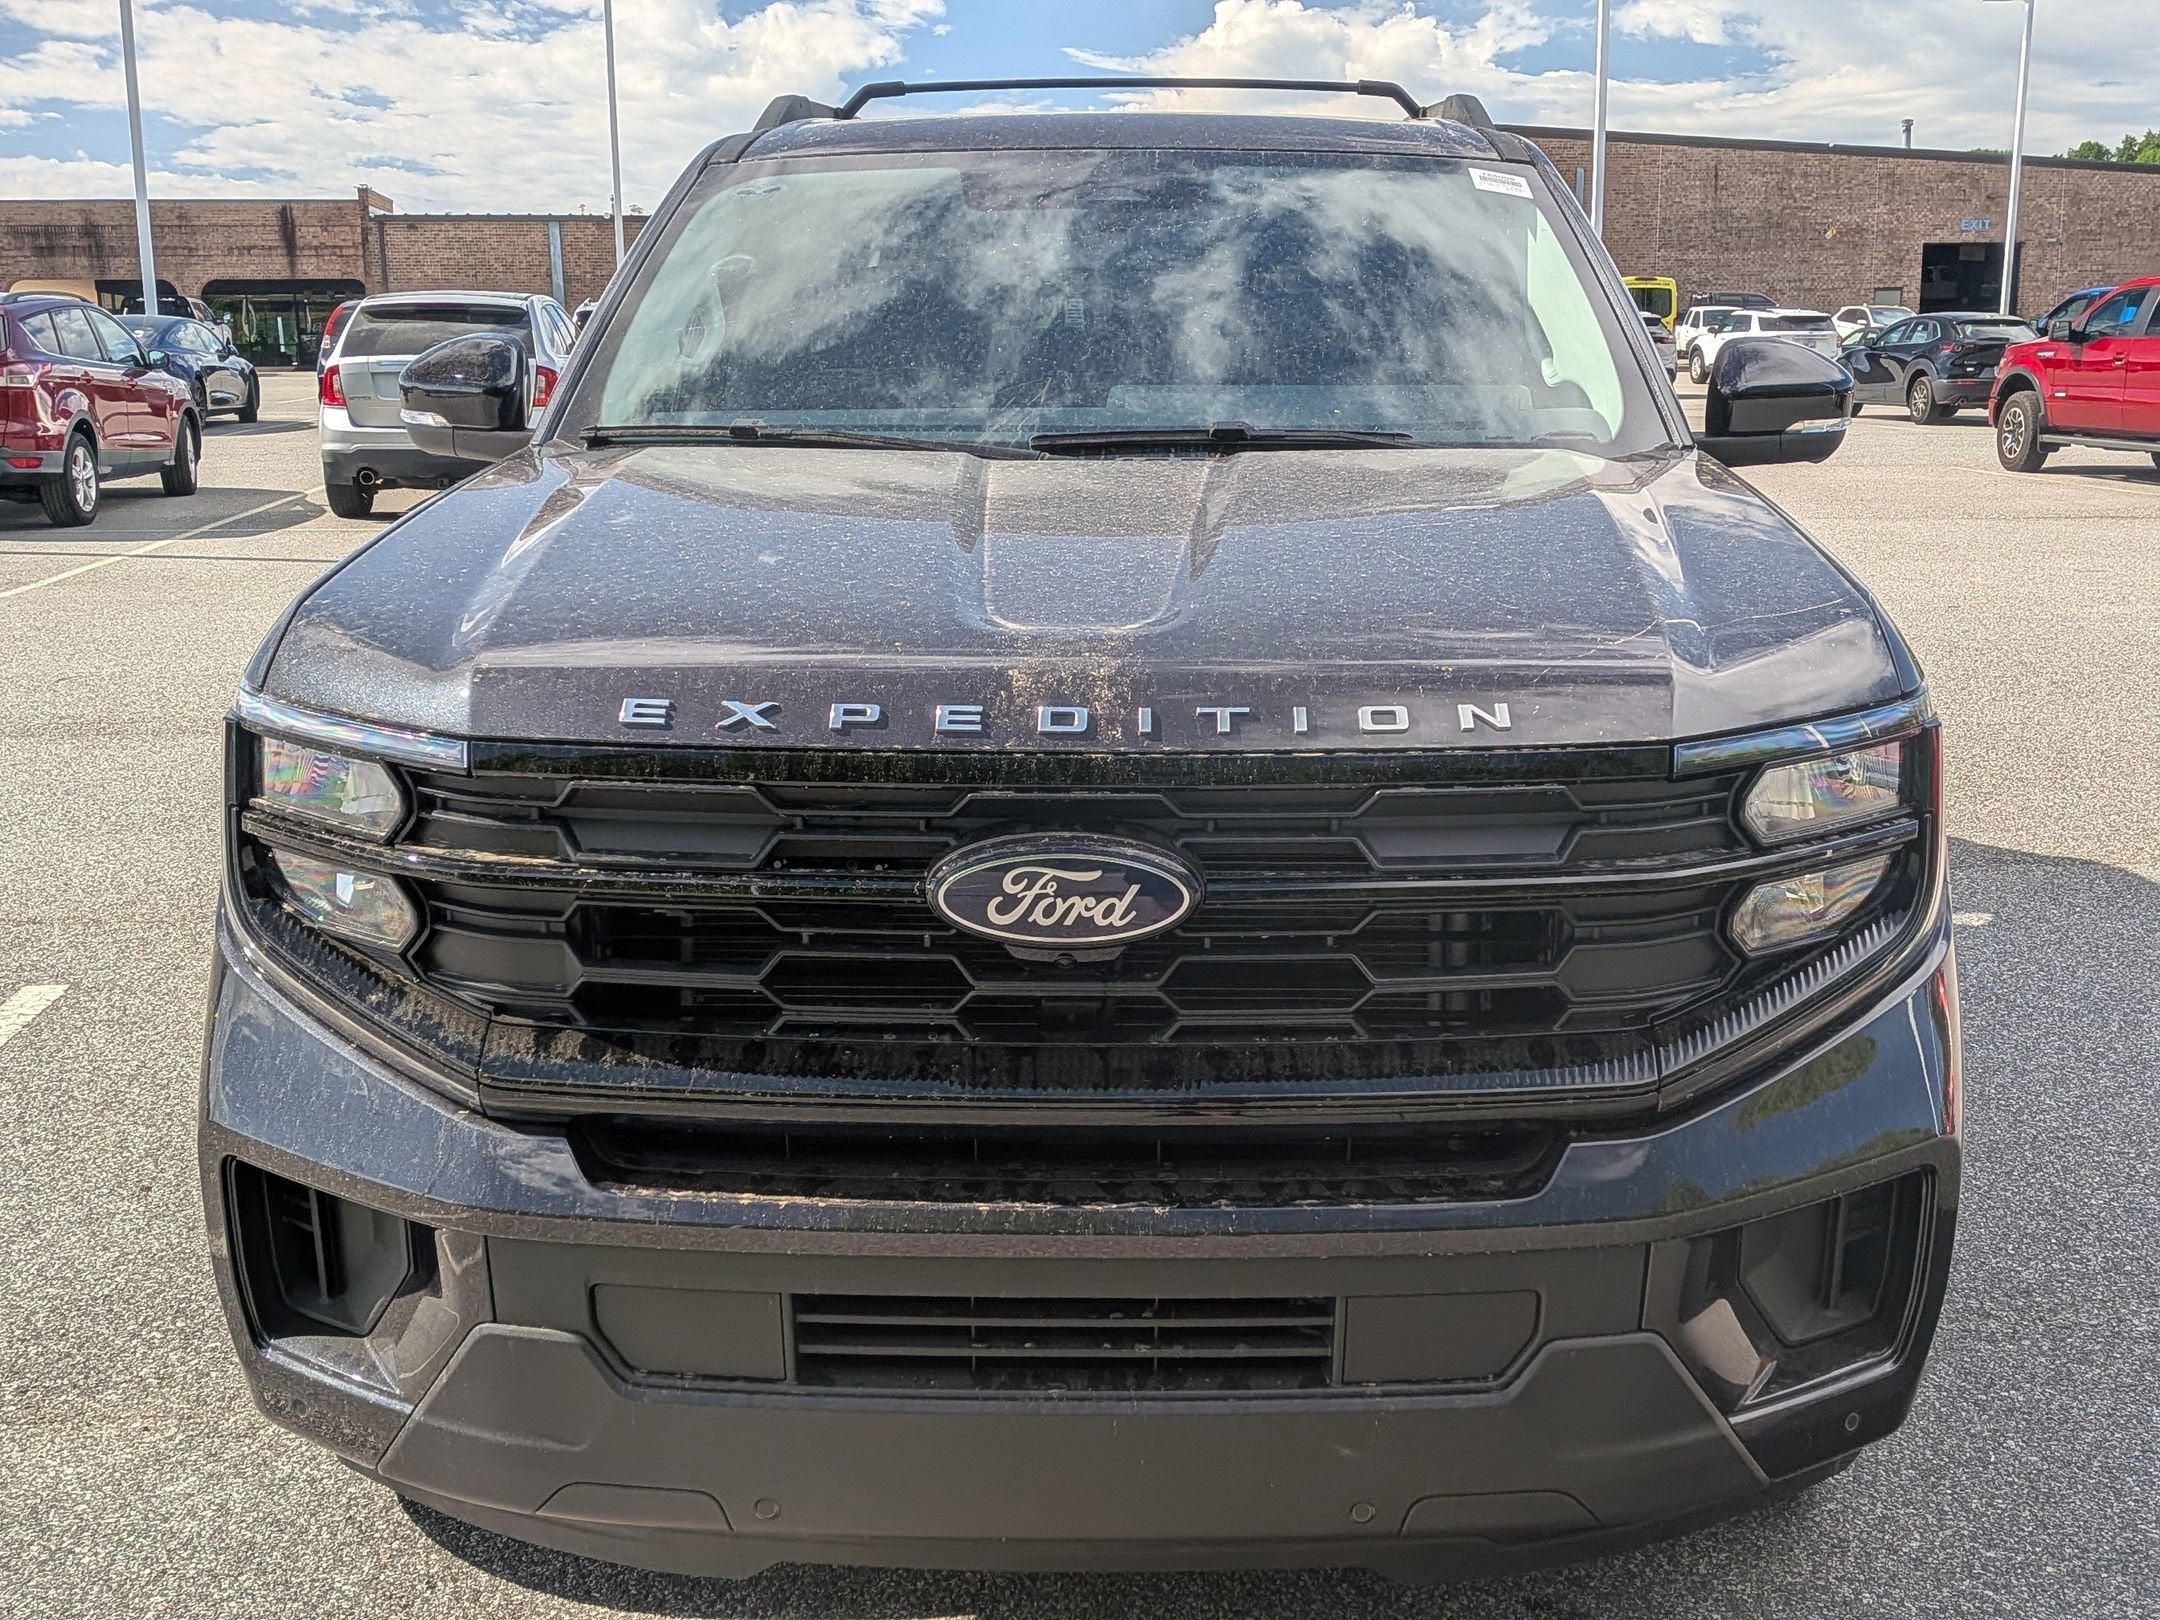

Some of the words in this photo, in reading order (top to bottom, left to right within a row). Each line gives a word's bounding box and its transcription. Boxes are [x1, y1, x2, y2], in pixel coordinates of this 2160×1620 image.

[1960, 219, 1991, 231] EXIT
[618, 697, 1512, 735] EXPEDITION
[987, 866, 1141, 927] Ford
